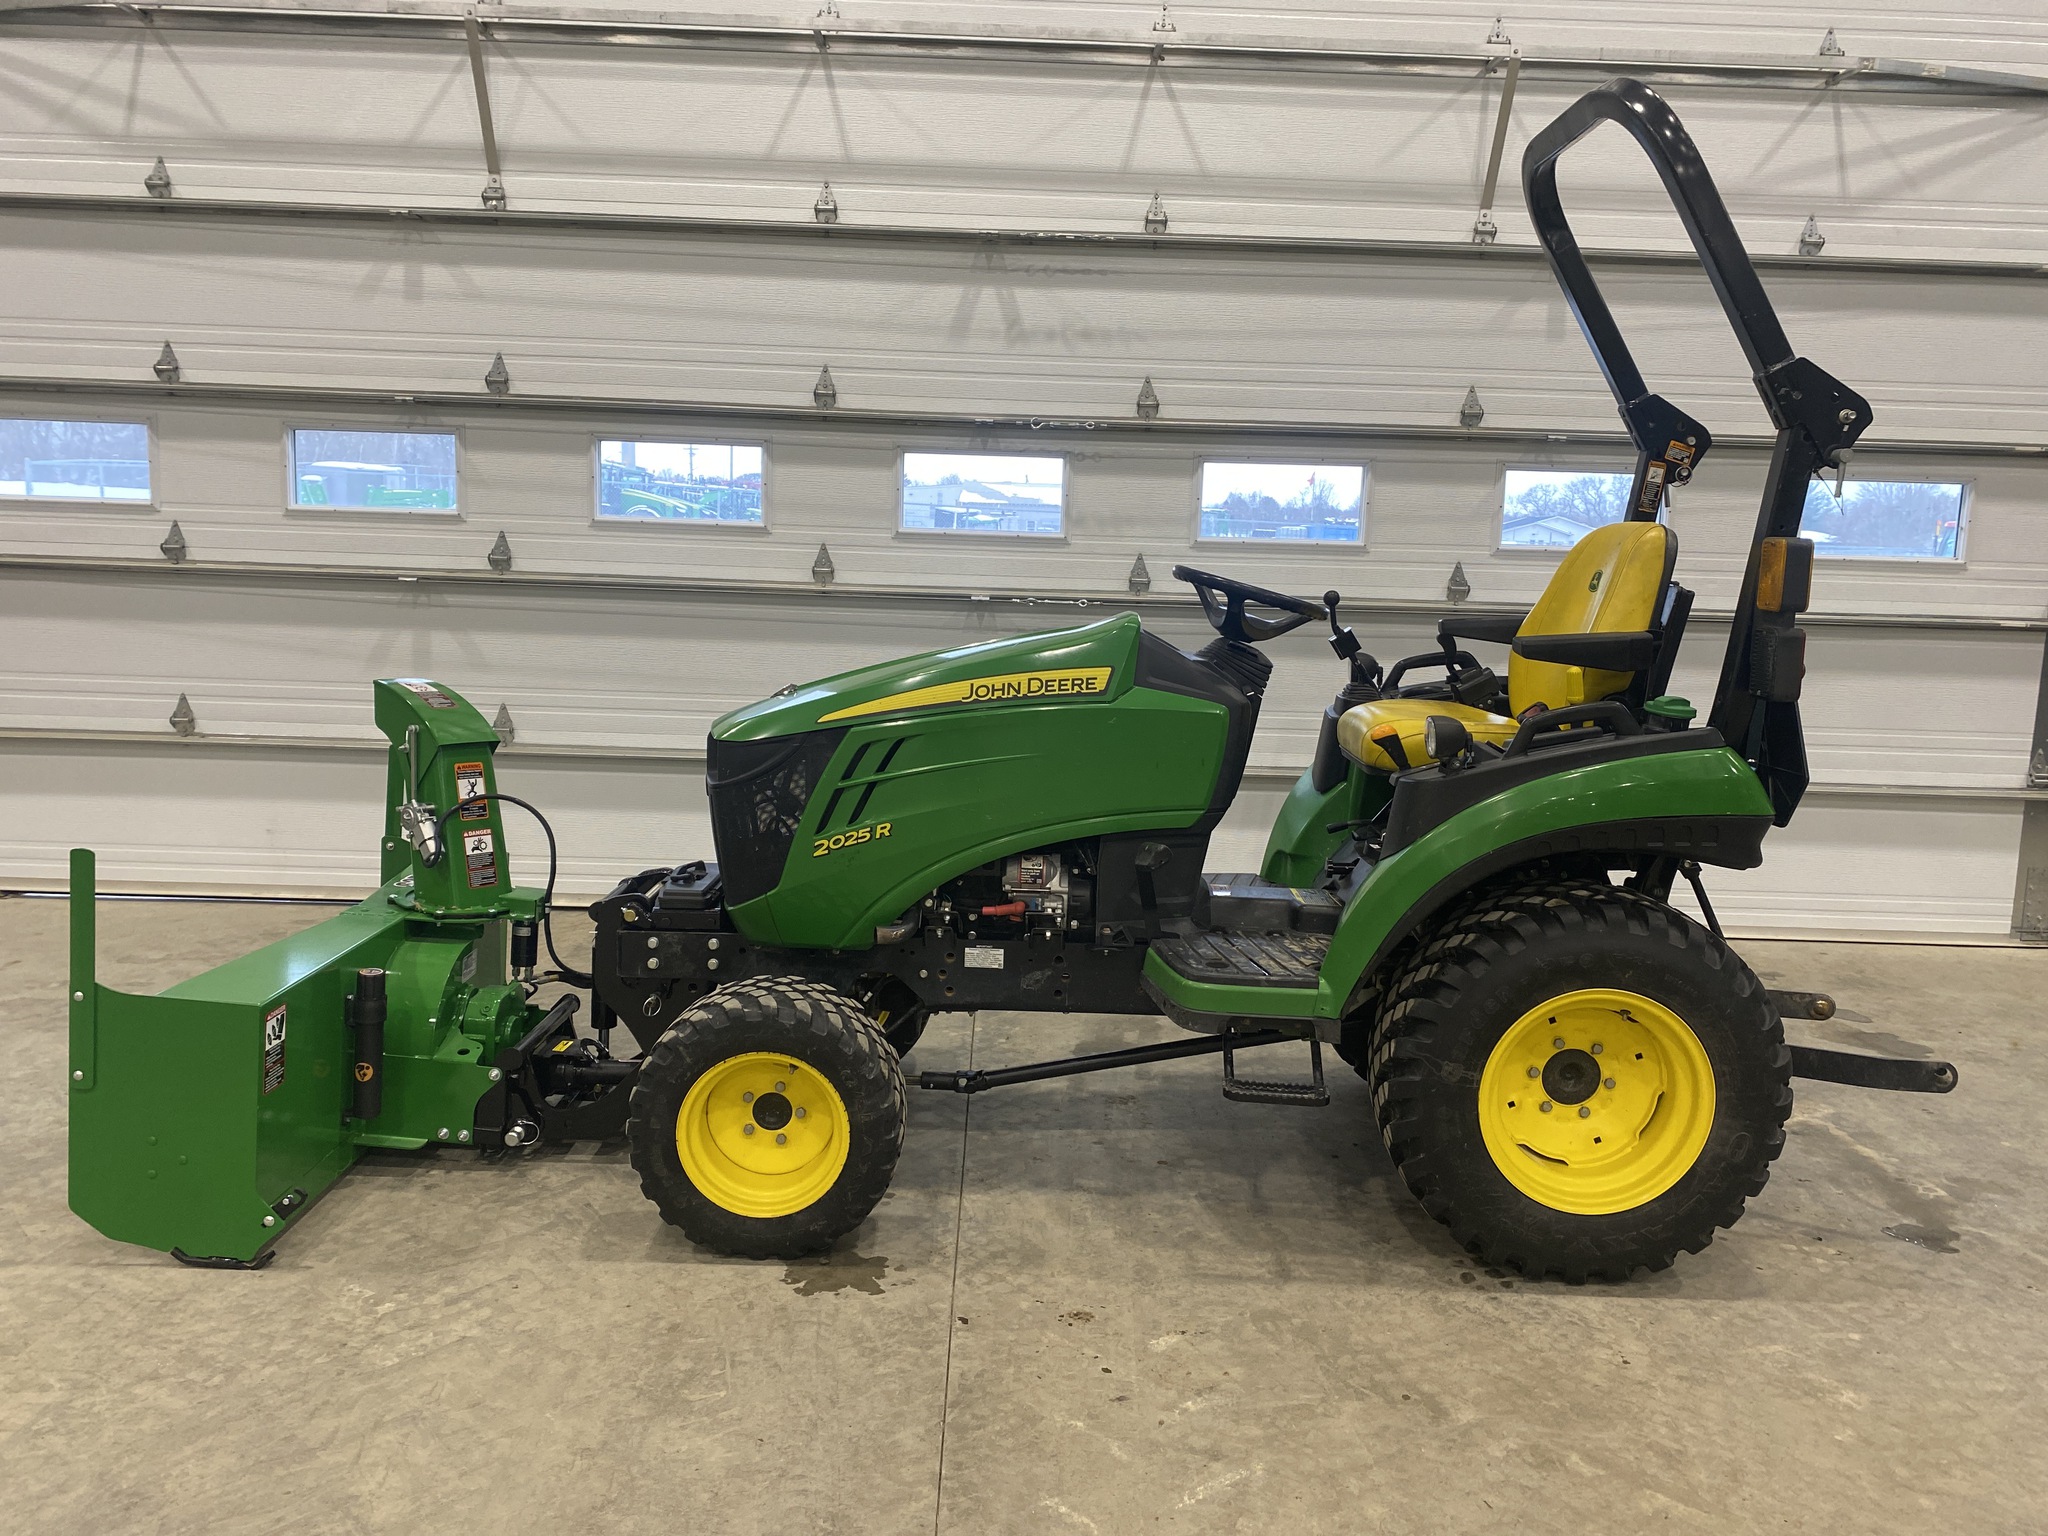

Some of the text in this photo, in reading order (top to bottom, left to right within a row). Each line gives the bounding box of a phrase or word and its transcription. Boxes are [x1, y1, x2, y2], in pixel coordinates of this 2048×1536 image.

[961, 677, 1098, 701] JOHN DEERE
[812, 822, 892, 857] 2025 R
